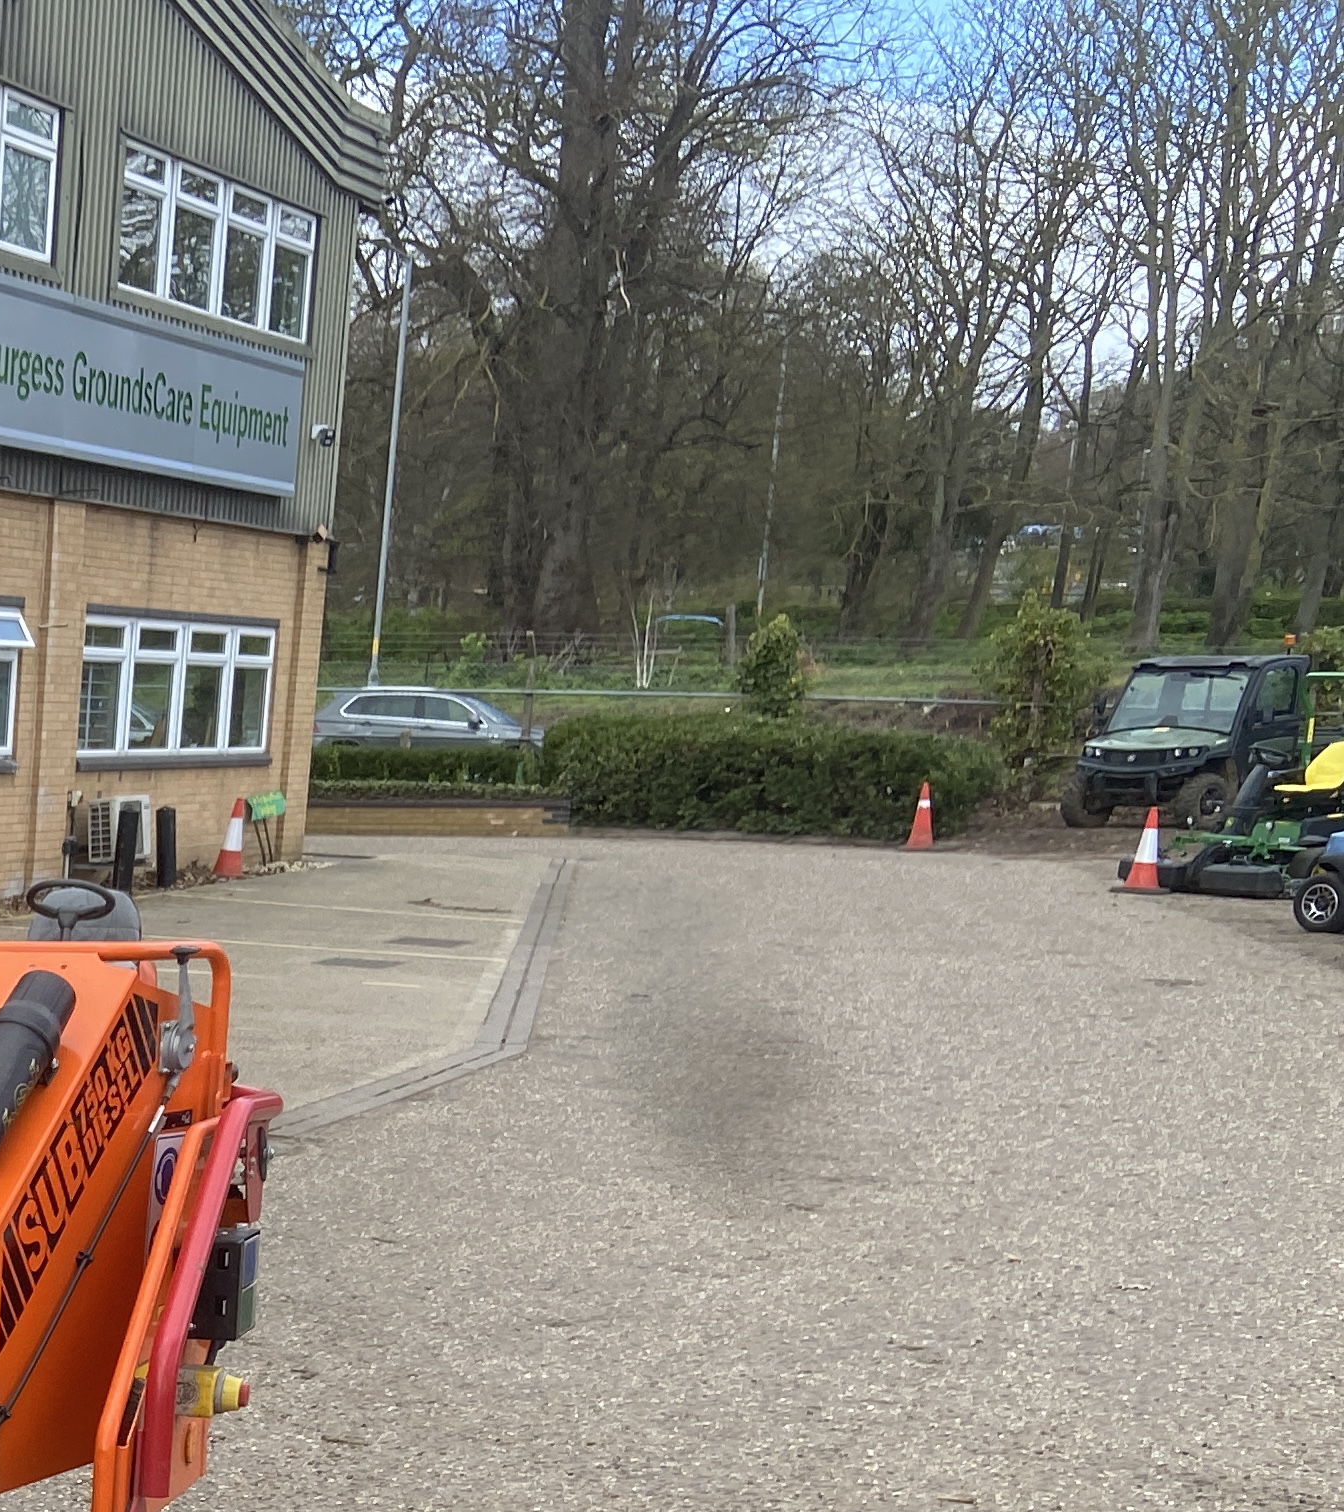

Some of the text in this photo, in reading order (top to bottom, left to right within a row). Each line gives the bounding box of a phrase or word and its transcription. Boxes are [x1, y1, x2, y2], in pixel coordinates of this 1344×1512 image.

[72, 350, 193, 426] GroundsCare
[200, 383, 289, 449] Equipment
[82, 1056, 141, 1168] DIESEL
[18, 1122, 87, 1273] SUB
